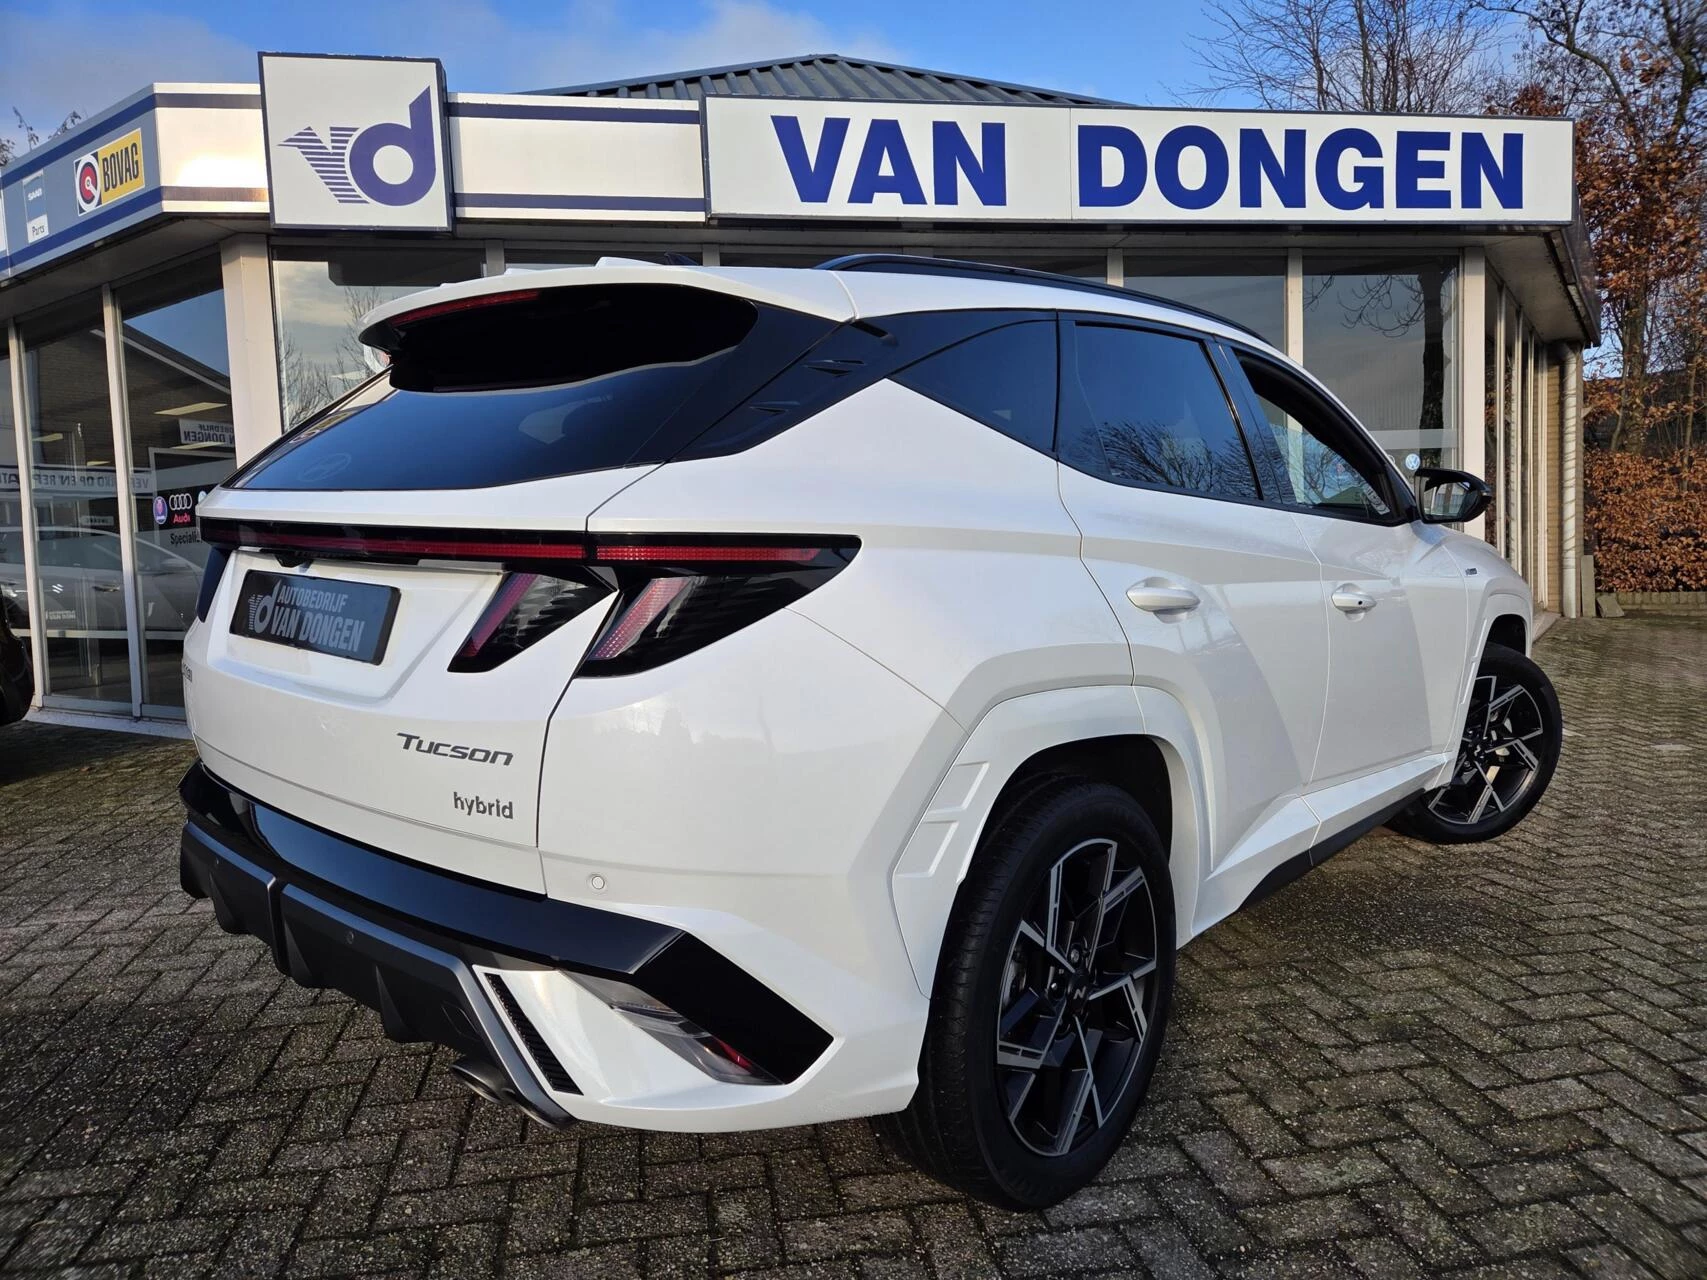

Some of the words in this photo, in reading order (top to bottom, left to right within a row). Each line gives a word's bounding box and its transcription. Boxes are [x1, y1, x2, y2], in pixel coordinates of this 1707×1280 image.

[102, 142, 139, 192] BOVAG
[771, 114, 1006, 206] VAN
[1078, 125, 1524, 210] DONGEN
[173, 512, 191, 524] Audi
[170, 531, 198, 546] Speciali
[277, 585, 349, 613] AUTOBEDRIJF
[270, 605, 301, 639] VAN
[298, 612, 365, 652] DONGEN
[453, 791, 514, 820] hybrid
